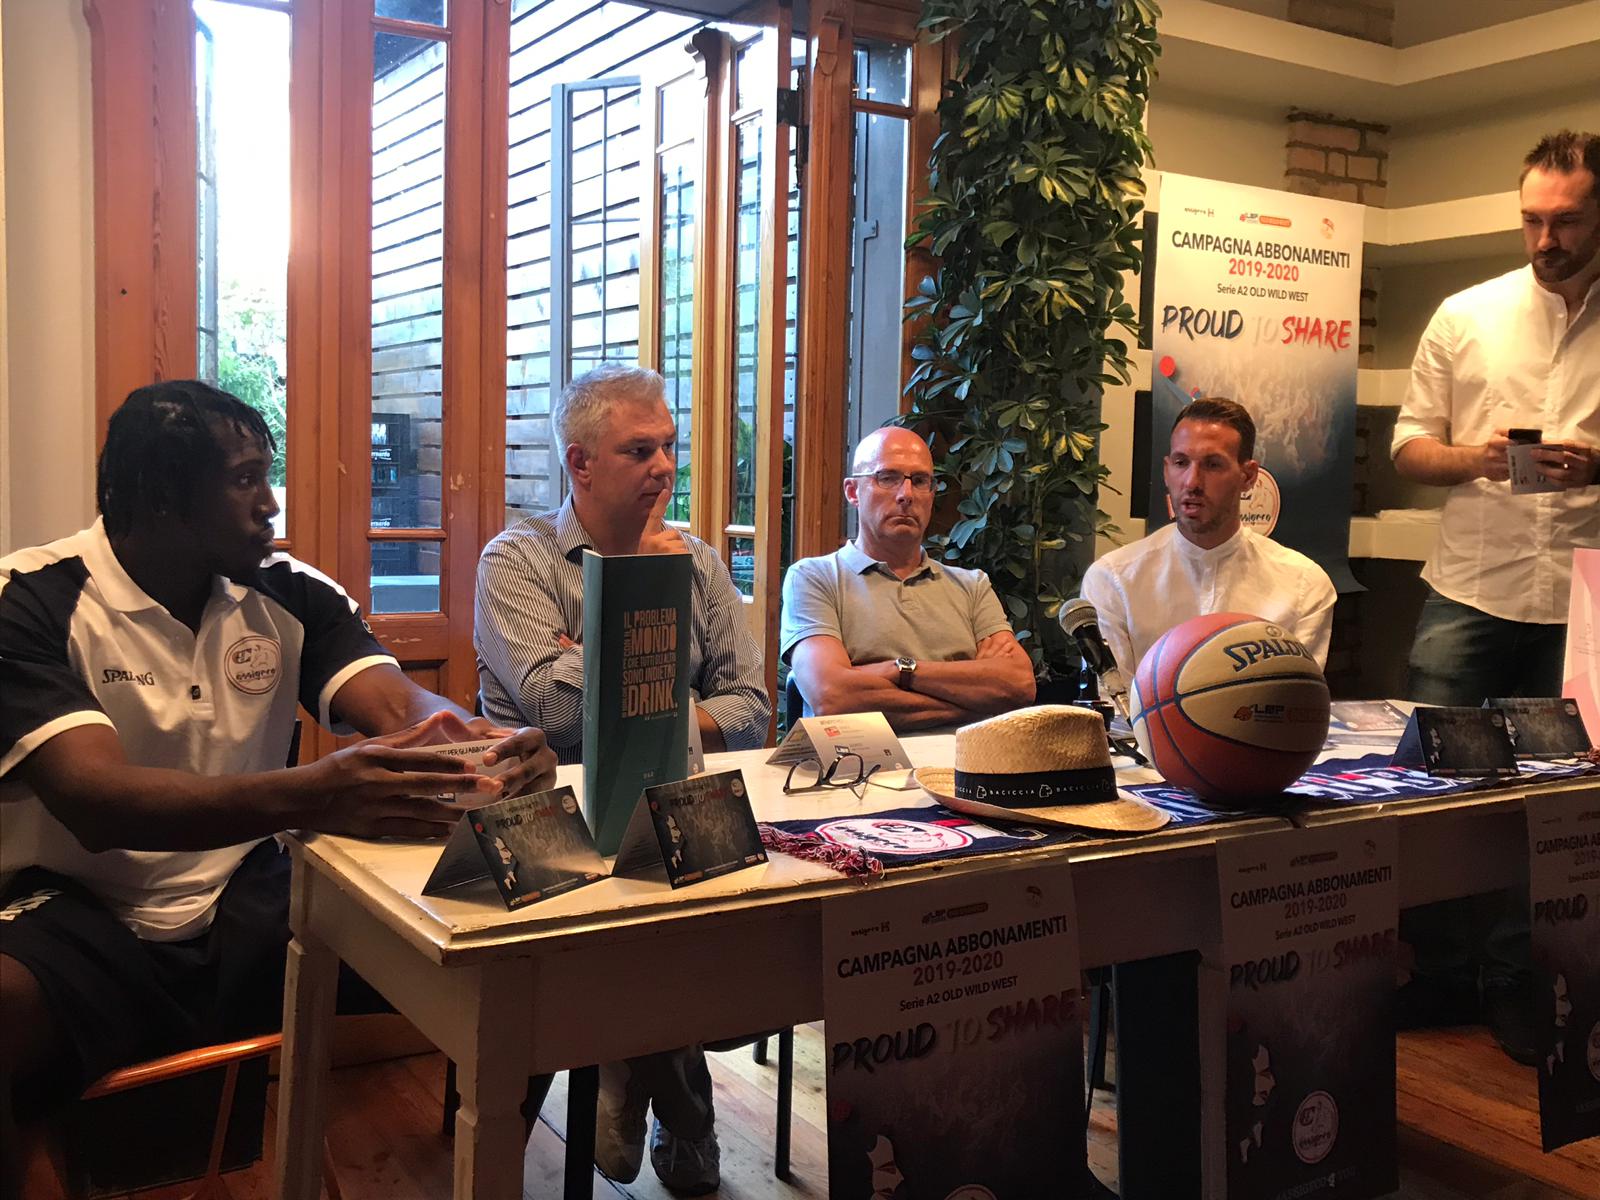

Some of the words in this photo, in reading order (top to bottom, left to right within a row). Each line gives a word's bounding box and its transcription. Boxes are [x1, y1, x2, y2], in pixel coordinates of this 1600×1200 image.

[1172, 230, 1255, 257] CAMPAGNA
[1255, 241, 1350, 268] ABBONAMENTI
[1228, 258, 1299, 282] 2019-2020
[1217, 283, 1236, 295] Serie
[1237, 285, 1248, 296] A2
[1250, 287, 1266, 298] OLD
[1268, 288, 1287, 300] WILD
[1289, 290, 1309, 302] WEST
[1161, 304, 1244, 341] PROUD
[1281, 315, 1352, 352] SHARE
[623, 610, 632, 629] IL
[634, 607, 677, 628] PROBLEMA
[632, 624, 677, 656] MONDO
[623, 667, 644, 685] SONO
[989, 789, 1035, 797] BACICCIA
[1536, 834, 1590, 855] CAMPAGNA
[1230, 881, 1306, 910] CAMPAGNA
[1307, 865, 1392, 897] ABBONAMENTI
[1284, 893, 1347, 920] 2019-2020
[1534, 893, 1588, 927] PROUD
[837, 941, 943, 979] CAMPAGNA
[945, 914, 1068, 958] ABBONAMENTI
[912, 950, 1004, 987] 2019-2020
[1230, 950, 1300, 993] PROUD
[900, 996, 925, 1012] Serie
[926, 992, 940, 1007] A2
[942, 988, 963, 1003] OLD
[964, 983, 990, 1000] WILD
[991, 975, 1019, 993] WEST
[831, 1022, 937, 1077] PROUD
[986, 988, 1080, 1041] SHARE
